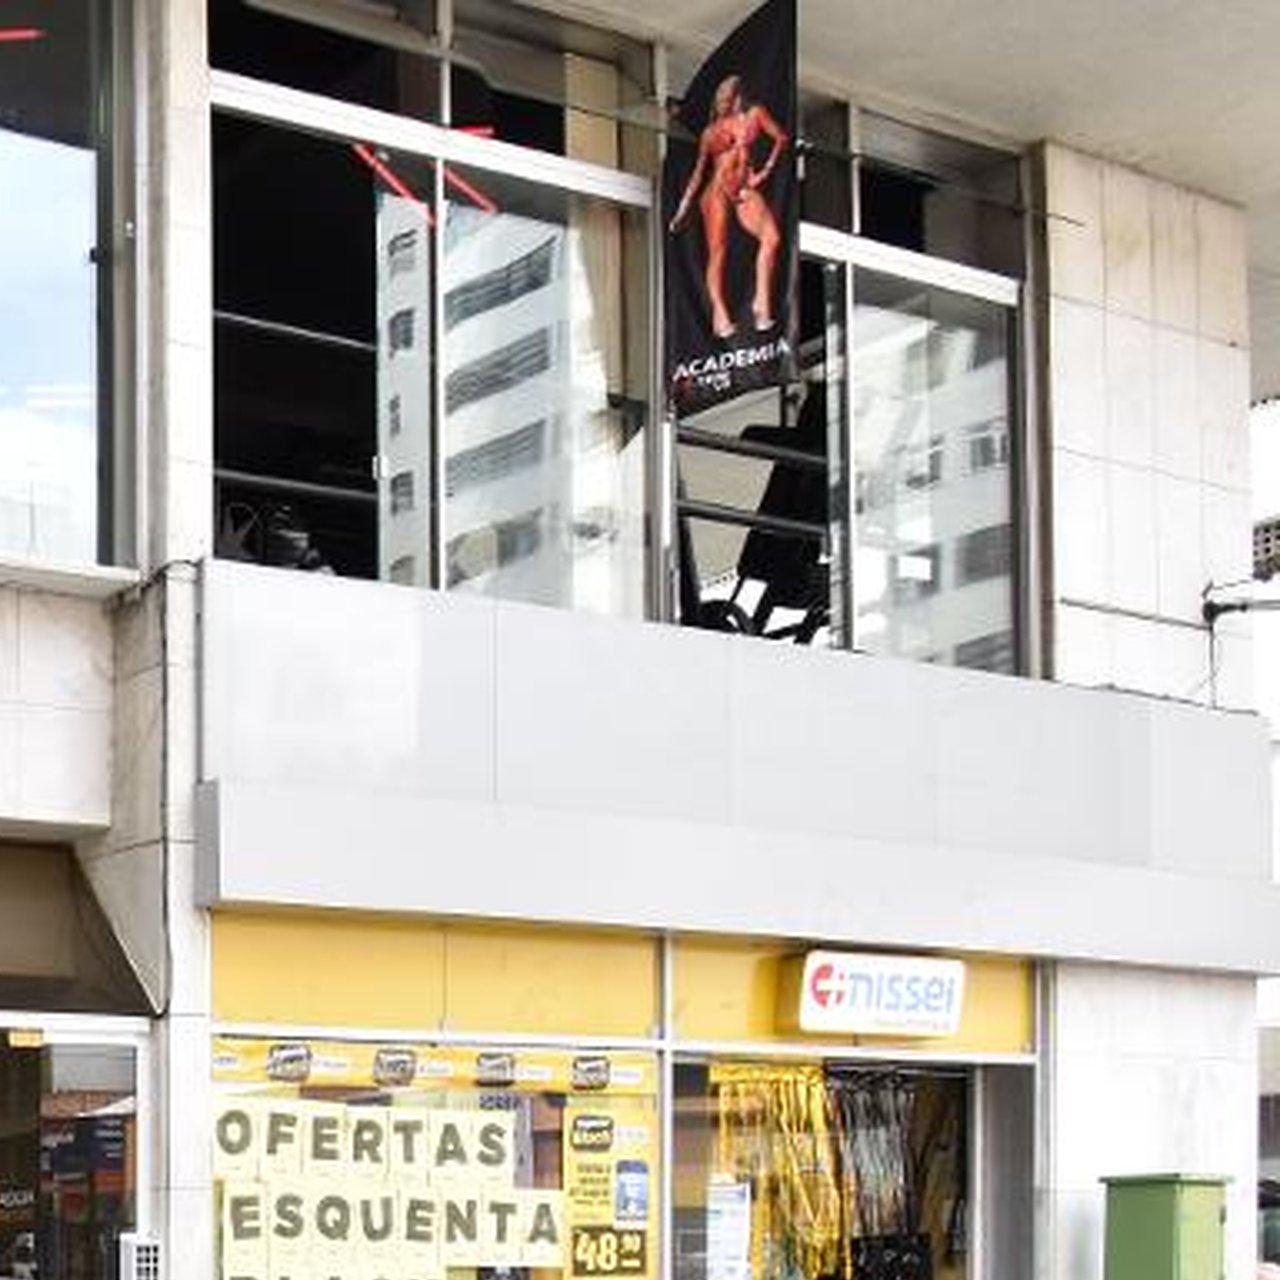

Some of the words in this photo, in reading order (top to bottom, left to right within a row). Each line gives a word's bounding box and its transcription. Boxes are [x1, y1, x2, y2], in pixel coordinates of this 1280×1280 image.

[672, 337, 791, 381] ACADEMIA
[849, 970, 955, 1014] nissei
[216, 1109, 507, 1167] OFERTAS
[229, 1195, 558, 1244] ESQUENTA
[575, 1231, 619, 1272] 48
